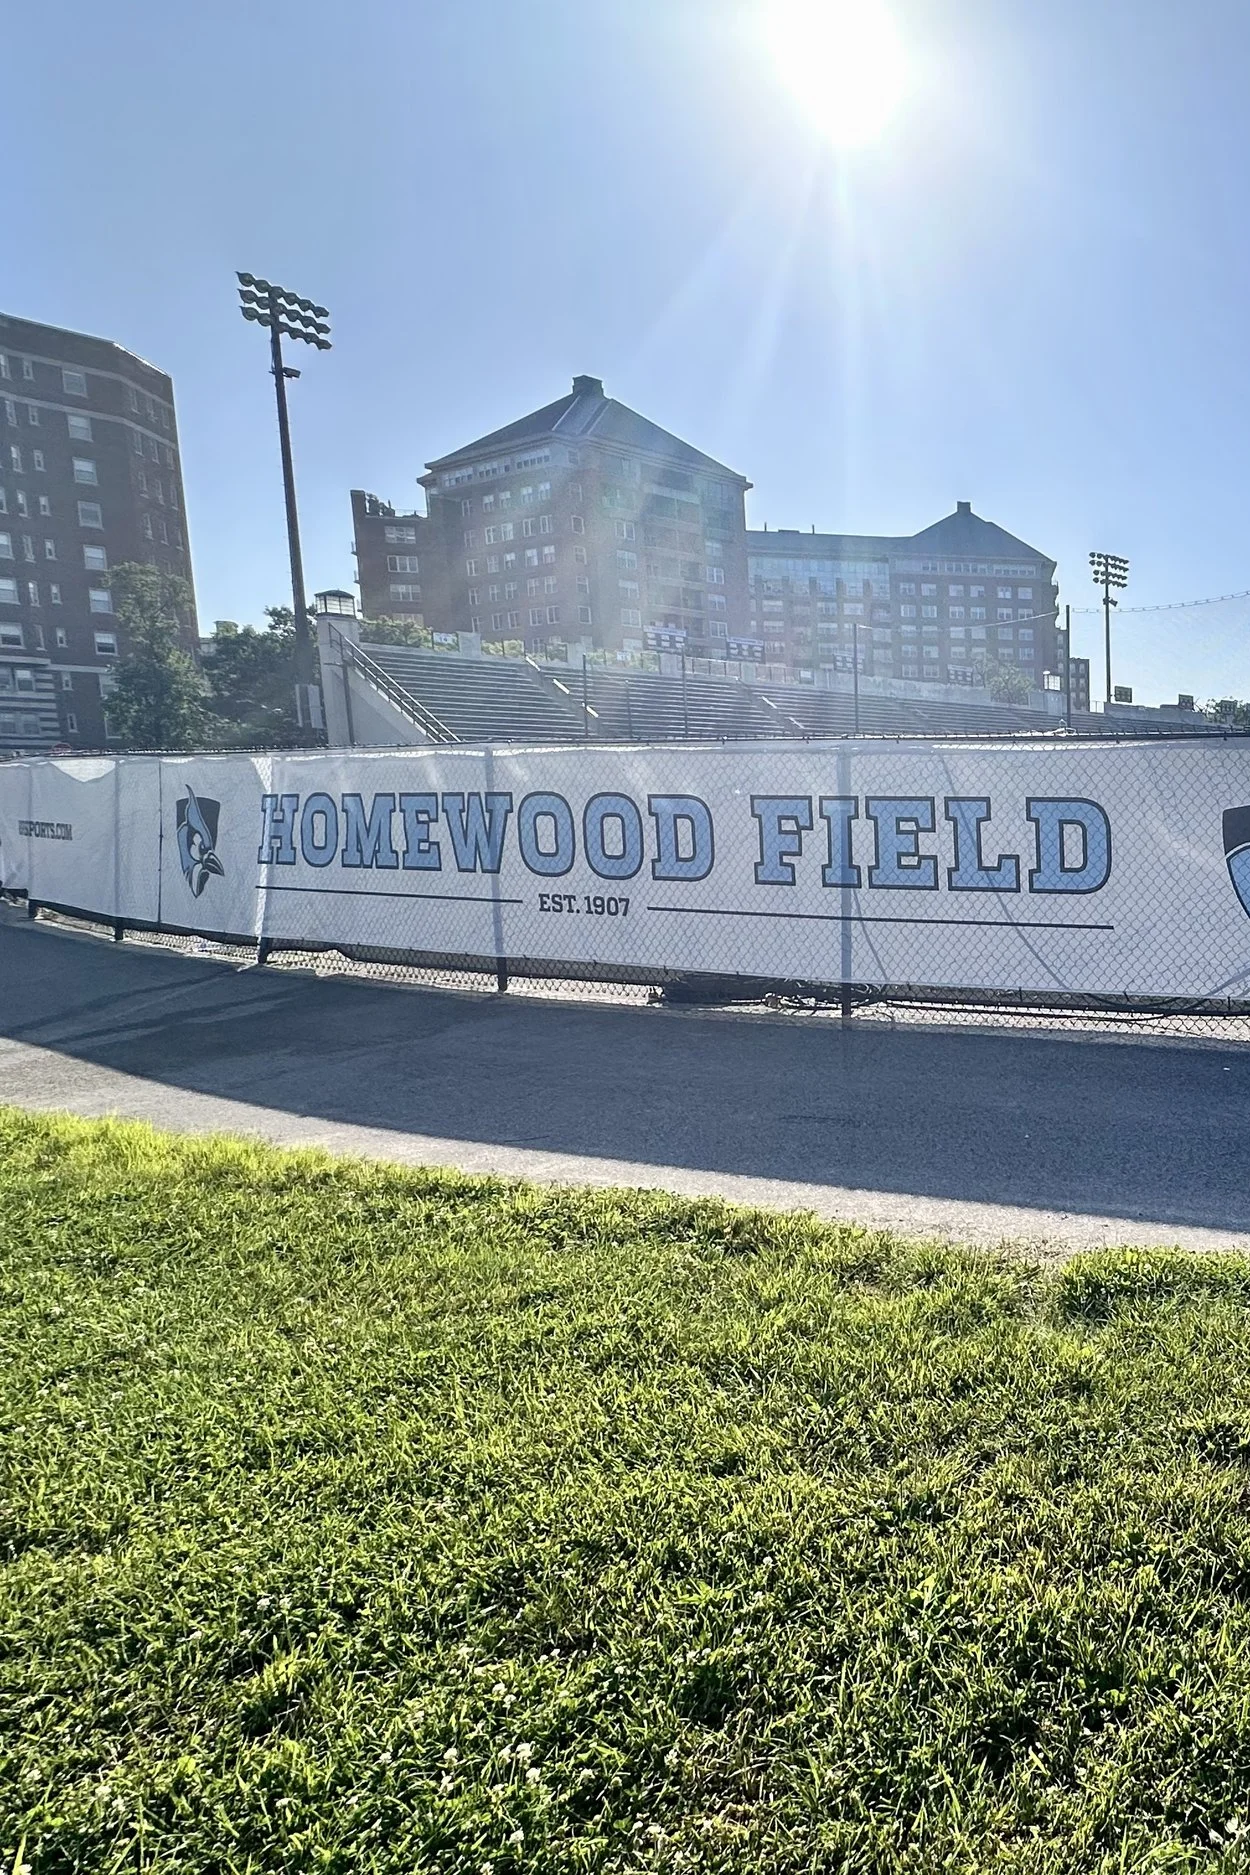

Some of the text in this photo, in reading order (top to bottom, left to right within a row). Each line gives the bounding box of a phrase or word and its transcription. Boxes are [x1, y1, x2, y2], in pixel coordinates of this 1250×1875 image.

[257, 791, 1111, 894] HOMEWOOD FIELD
[539, 894, 630, 917] EST. 1907
